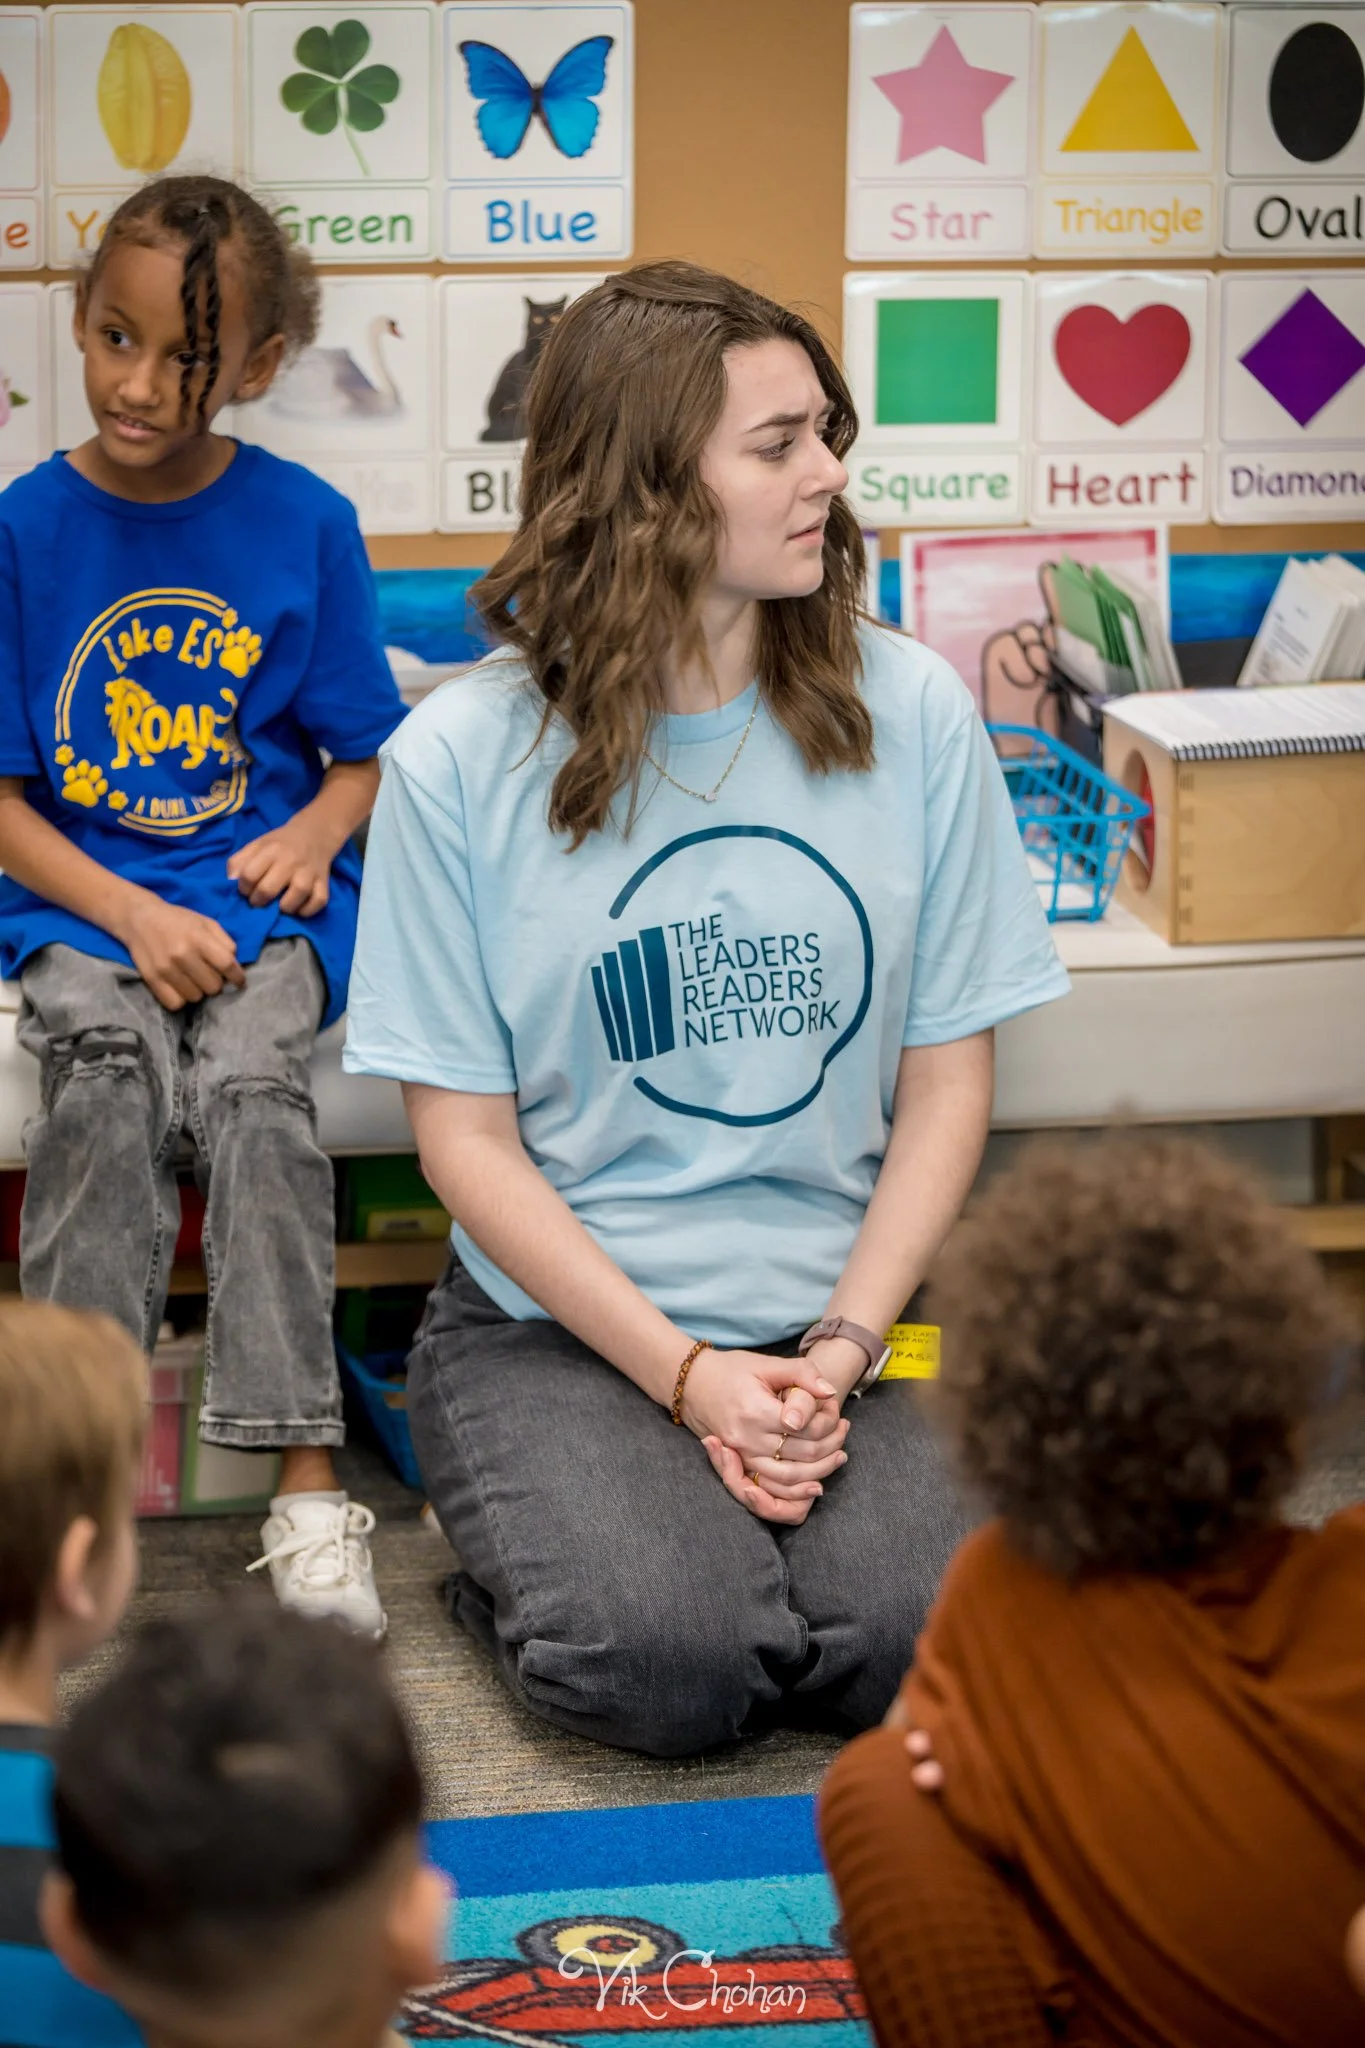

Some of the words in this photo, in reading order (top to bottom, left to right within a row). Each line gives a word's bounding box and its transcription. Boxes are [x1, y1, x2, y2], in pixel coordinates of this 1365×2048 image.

[274, 204, 413, 245] Green
[485, 200, 598, 244] Blue
[890, 201, 994, 241] Star
[1054, 197, 1205, 244] Triangle
[1255, 194, 1363, 240] Oval
[466, 471, 514, 514] Bl
[859, 465, 1011, 512] Square
[1048, 460, 1197, 507] Heart
[1230, 463, 1365, 498] Diamon
[101, 617, 174, 674] Lake
[667, 913, 724, 949] THE
[678, 932, 821, 982] LEADERS
[682, 967, 824, 1016] READERS
[684, 999, 841, 1048] NETWORK
[895, 1351, 937, 1362] PASS
